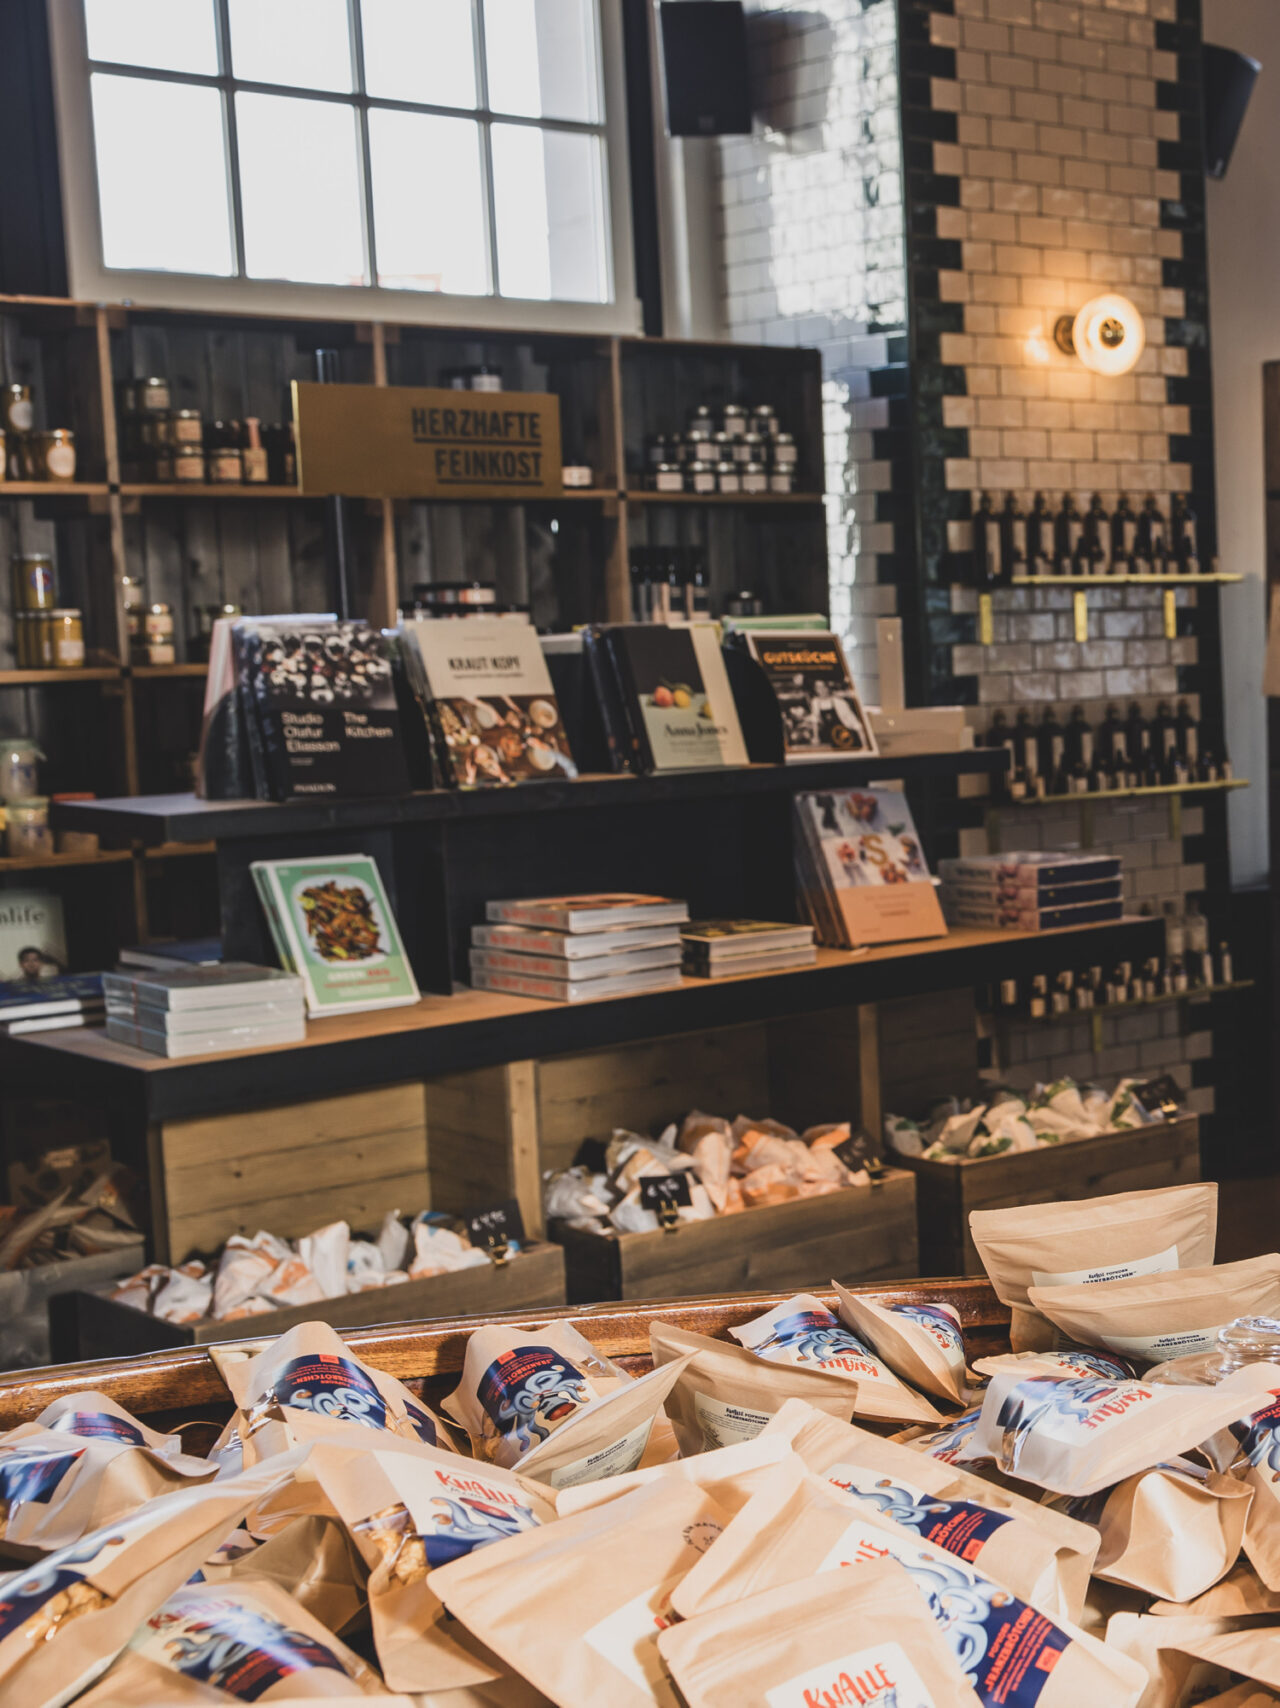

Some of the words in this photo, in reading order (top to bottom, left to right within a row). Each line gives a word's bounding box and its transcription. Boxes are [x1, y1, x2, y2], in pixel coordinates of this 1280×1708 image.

[411, 408, 542, 439] HERZHAFTE
[434, 448, 543, 478] FEINKOST
[447, 656, 487, 671] KRAUT
[491, 655, 520, 670] KOPF
[281, 711, 324, 725] Studio
[343, 711, 368, 725] The
[283, 725, 324, 739] Olafur
[345, 726, 394, 738] Kitchen
[286, 739, 341, 753] Eliasson
